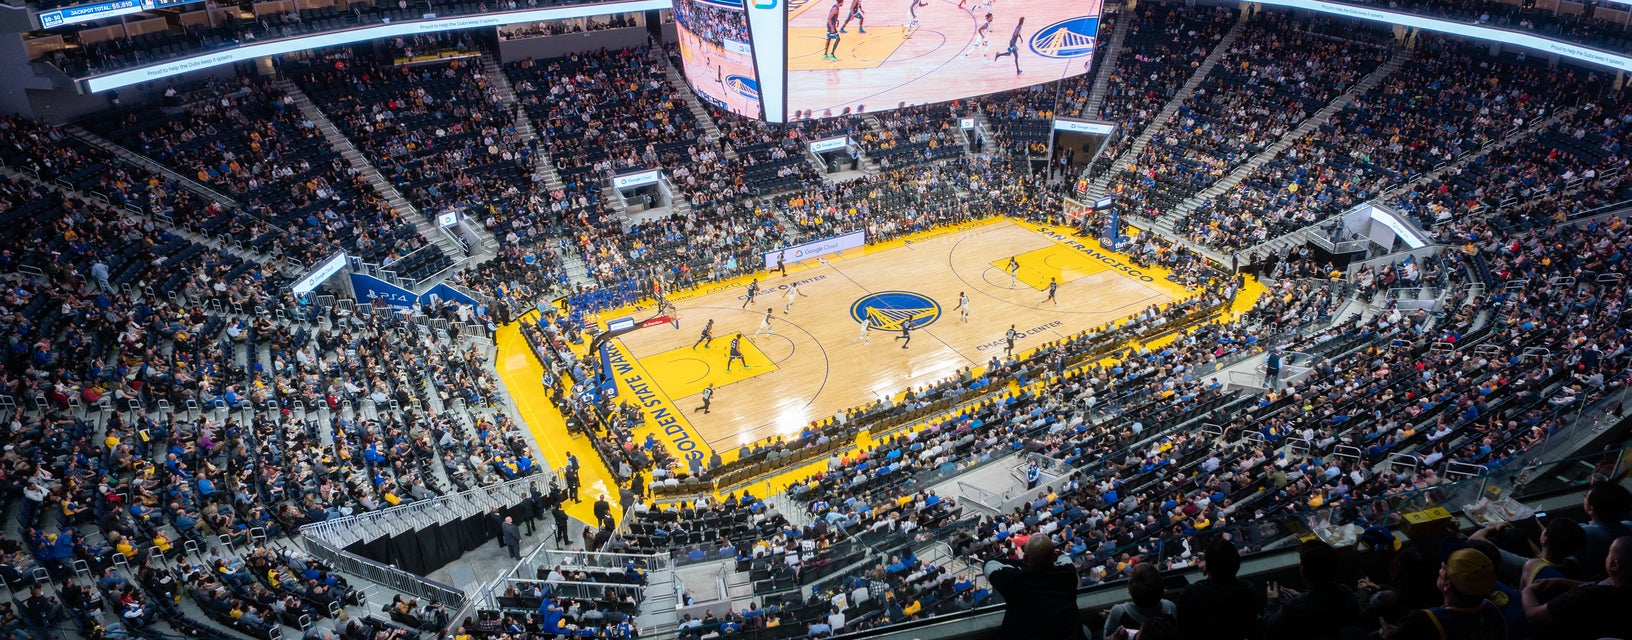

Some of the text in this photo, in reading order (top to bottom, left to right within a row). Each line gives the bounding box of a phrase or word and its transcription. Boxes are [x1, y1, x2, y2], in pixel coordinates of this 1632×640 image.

[70, 8, 94, 16] JACKPOT
[627, 176, 641, 184] Google
[804, 242, 839, 255] Google Cloud
[1037, 227, 1154, 282] SAN FRANCISCO
[379, 291, 408, 302] PS4
[976, 320, 1063, 352] CHAS CENTER
[624, 374, 663, 408] STATE
[651, 405, 705, 462] GOLDEN
